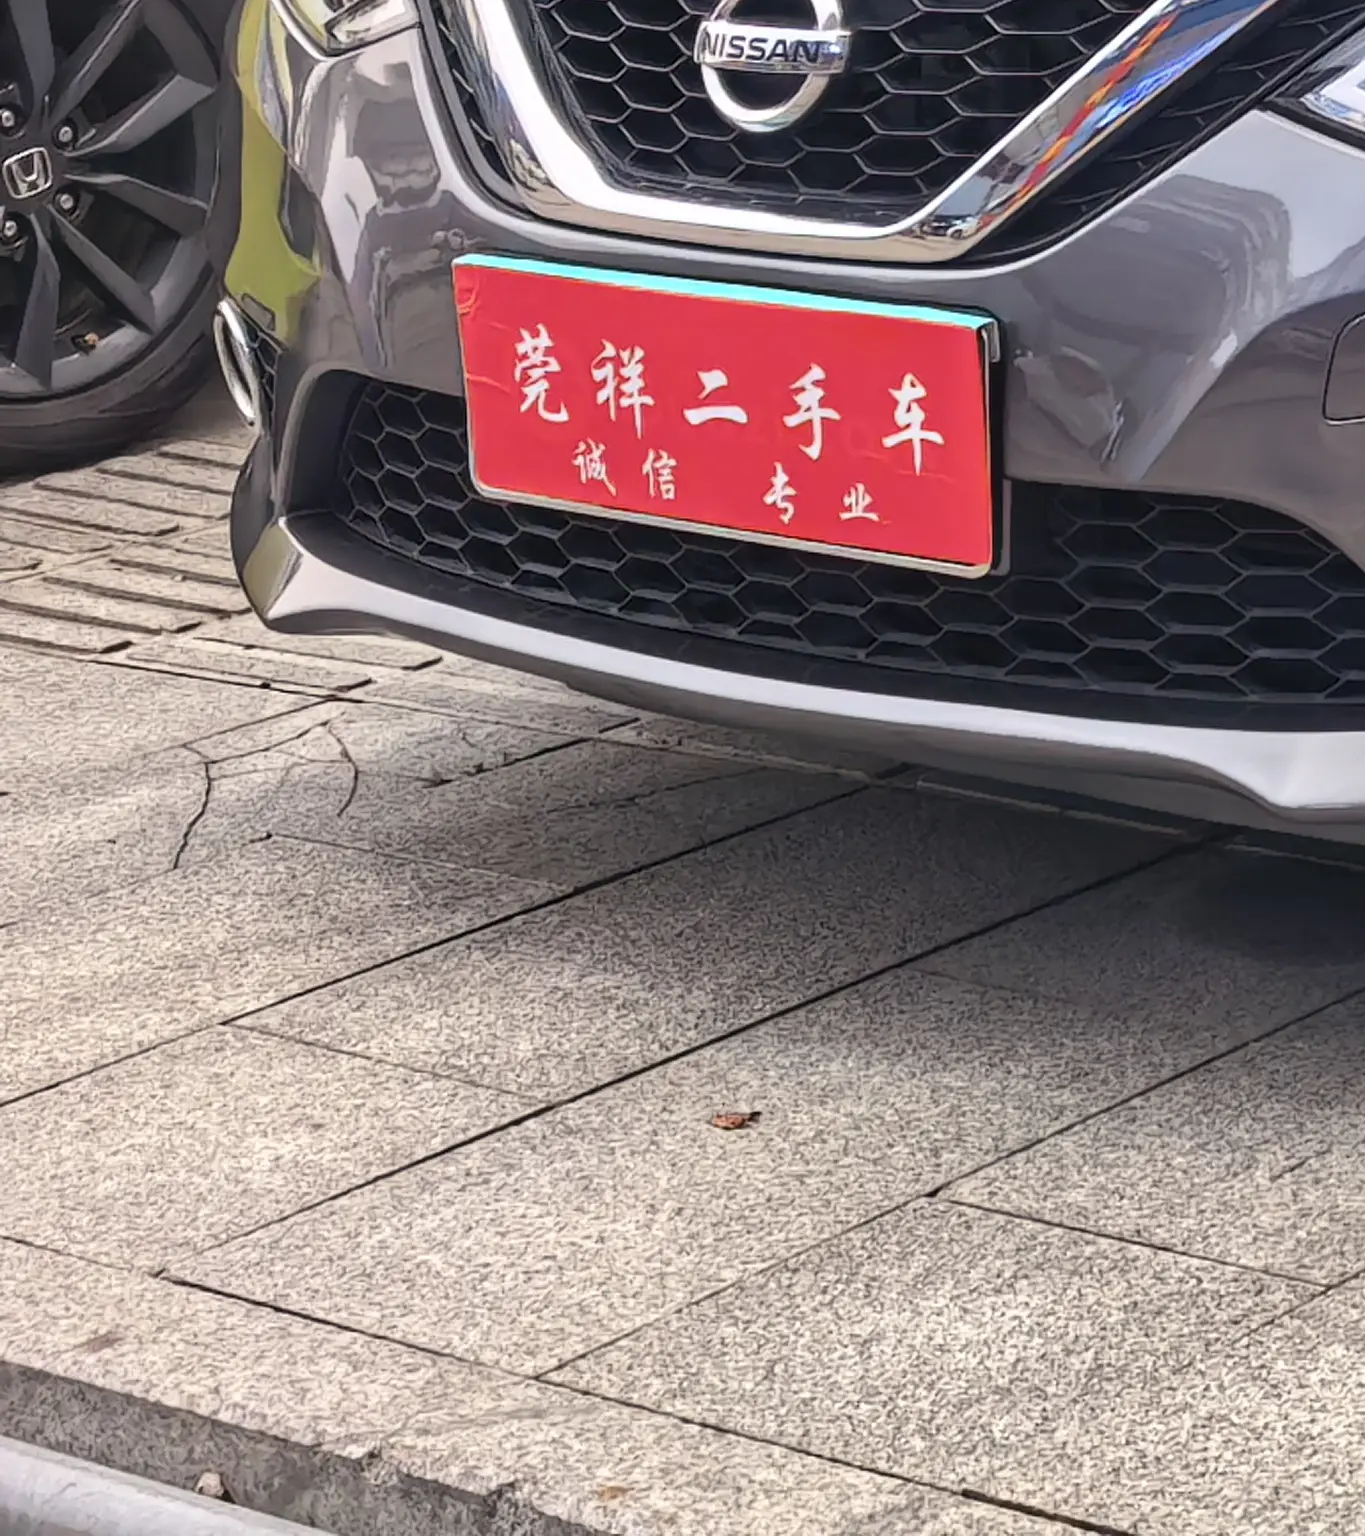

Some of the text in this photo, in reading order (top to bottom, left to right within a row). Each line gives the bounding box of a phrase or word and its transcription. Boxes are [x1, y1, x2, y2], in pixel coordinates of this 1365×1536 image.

[701, 28, 820, 63] NISSAN
[513, 323, 944, 476] 莞祥二手车
[572, 438, 880, 524] 诚信 专业
